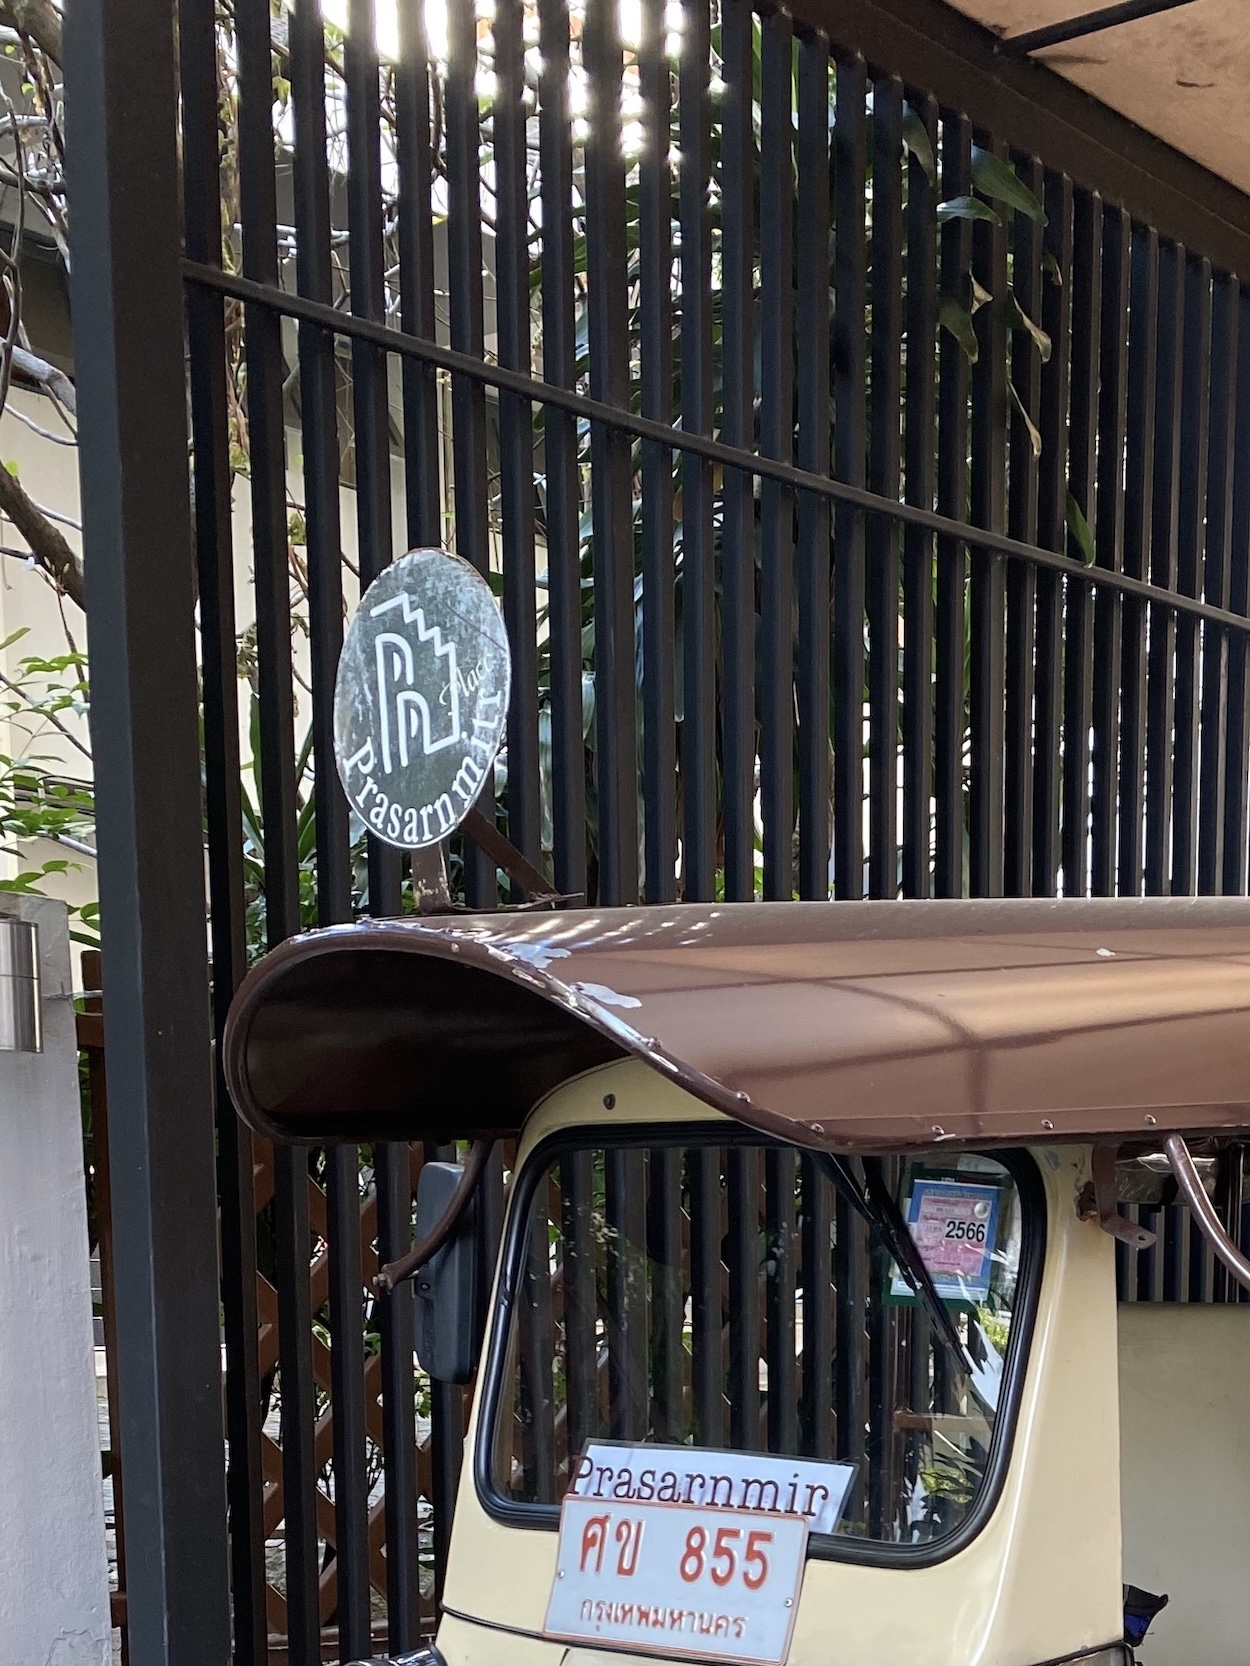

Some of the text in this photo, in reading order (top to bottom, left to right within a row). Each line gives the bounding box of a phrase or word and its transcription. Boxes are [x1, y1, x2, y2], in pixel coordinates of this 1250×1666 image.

[945, 1220, 985, 1242] 2566
[571, 1455, 829, 1516] Prasarnmir
[579, 1513, 774, 1590] ศข 855
[580, 1598, 749, 1639] กรุงเทพมหานคร
